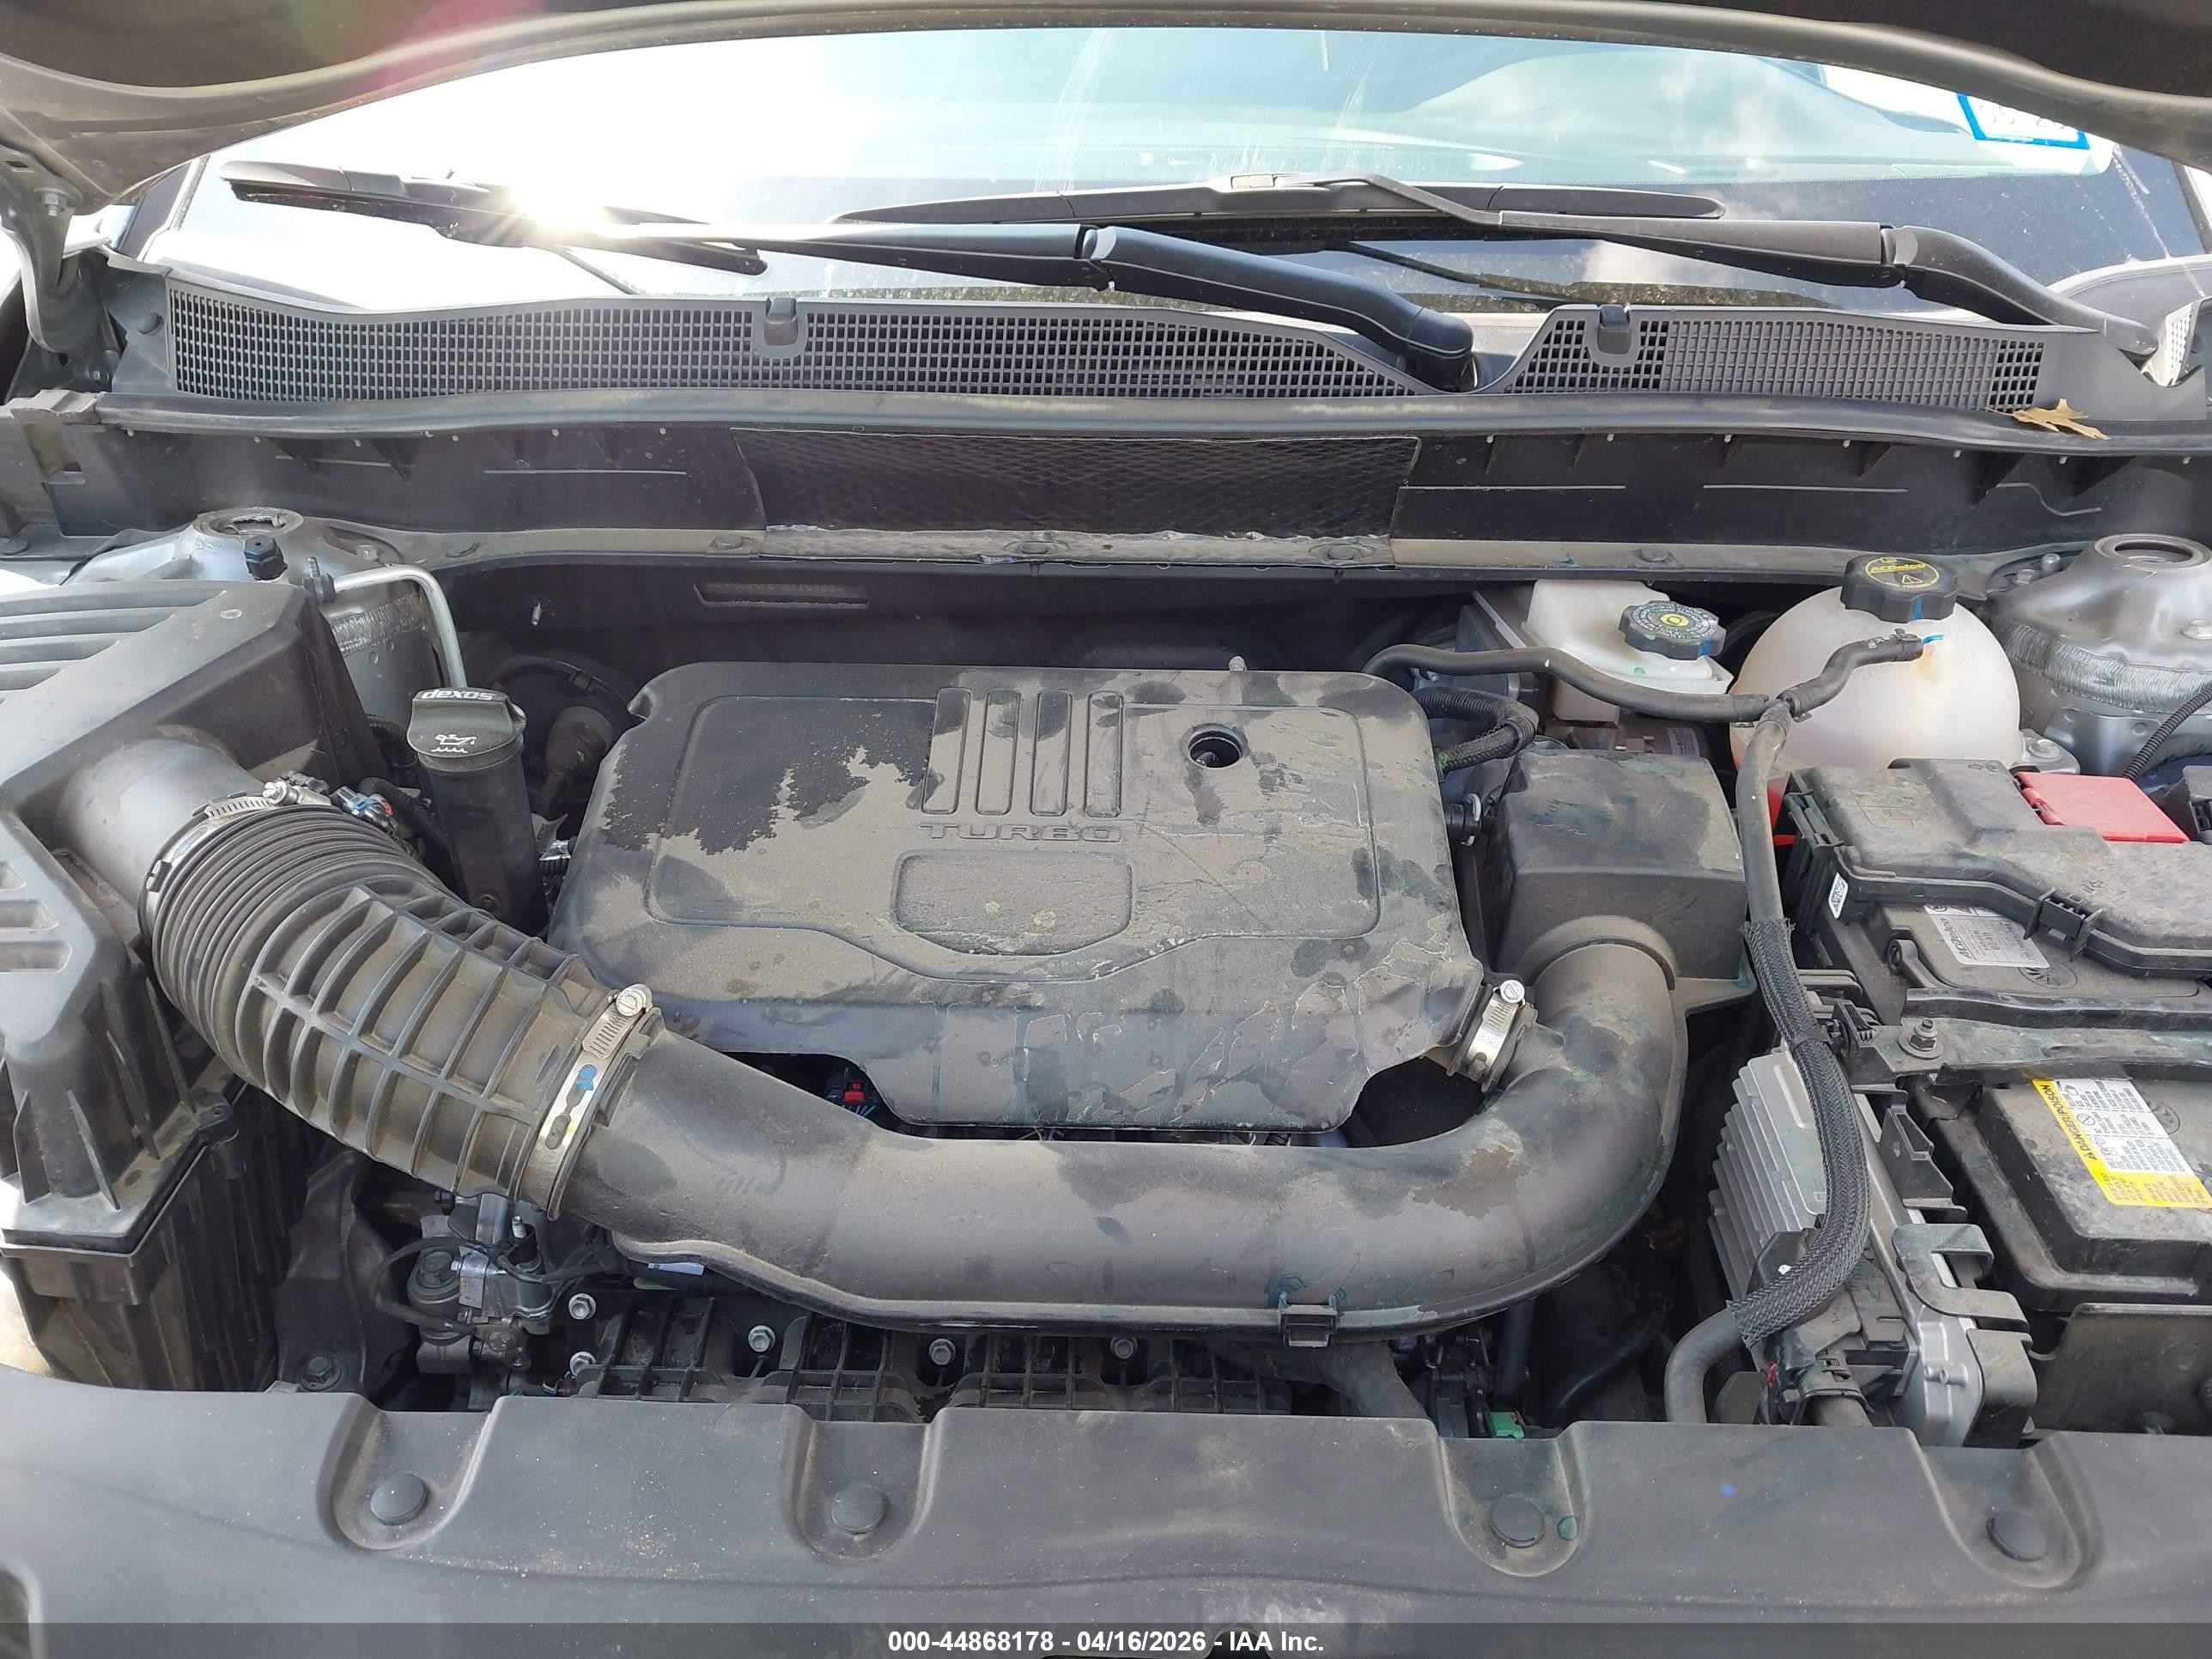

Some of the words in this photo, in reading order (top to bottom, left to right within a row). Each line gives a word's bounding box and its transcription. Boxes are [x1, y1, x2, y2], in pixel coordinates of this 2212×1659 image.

[1870, 562, 1926, 573] ACDelco
[421, 690, 495, 701] dexos
[919, 823, 1122, 843] TURBO
[1940, 917, 1972, 959] ACDelco
